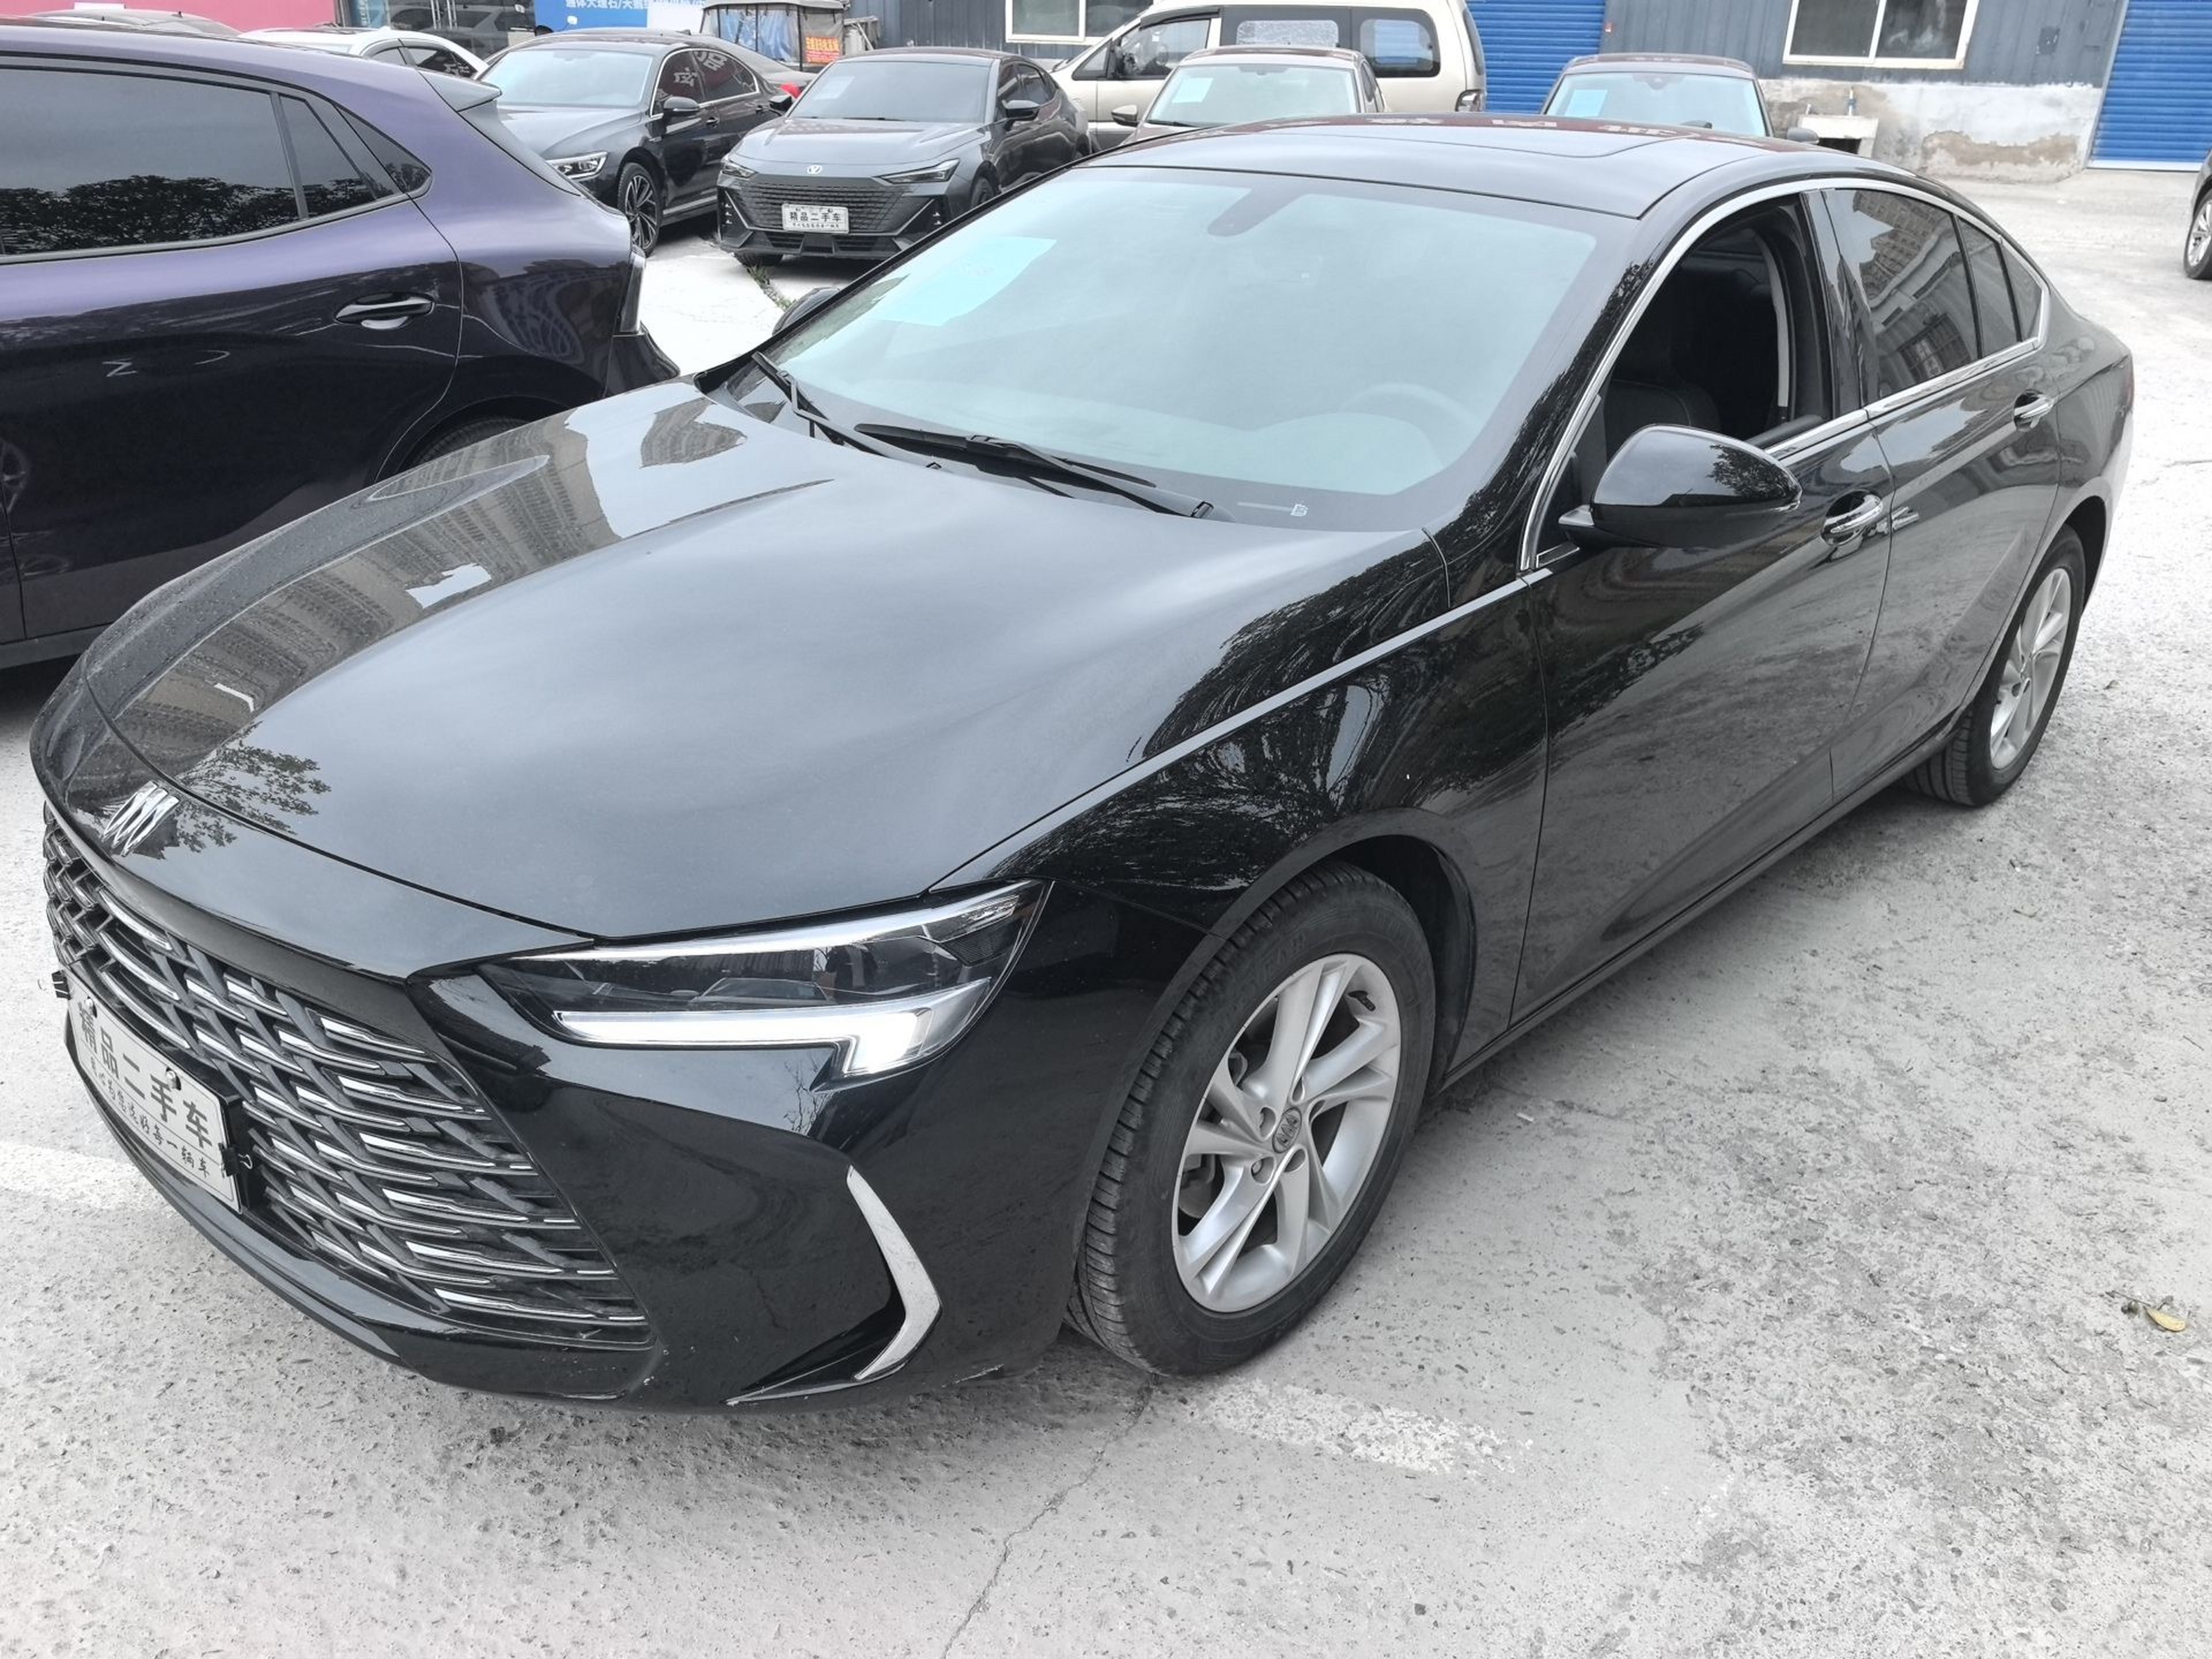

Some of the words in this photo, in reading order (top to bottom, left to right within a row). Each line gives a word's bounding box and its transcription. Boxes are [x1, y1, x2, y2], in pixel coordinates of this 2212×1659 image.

[790, 211, 841, 222] 精品二手车
[77, 1001, 213, 1149] 精品二手车
